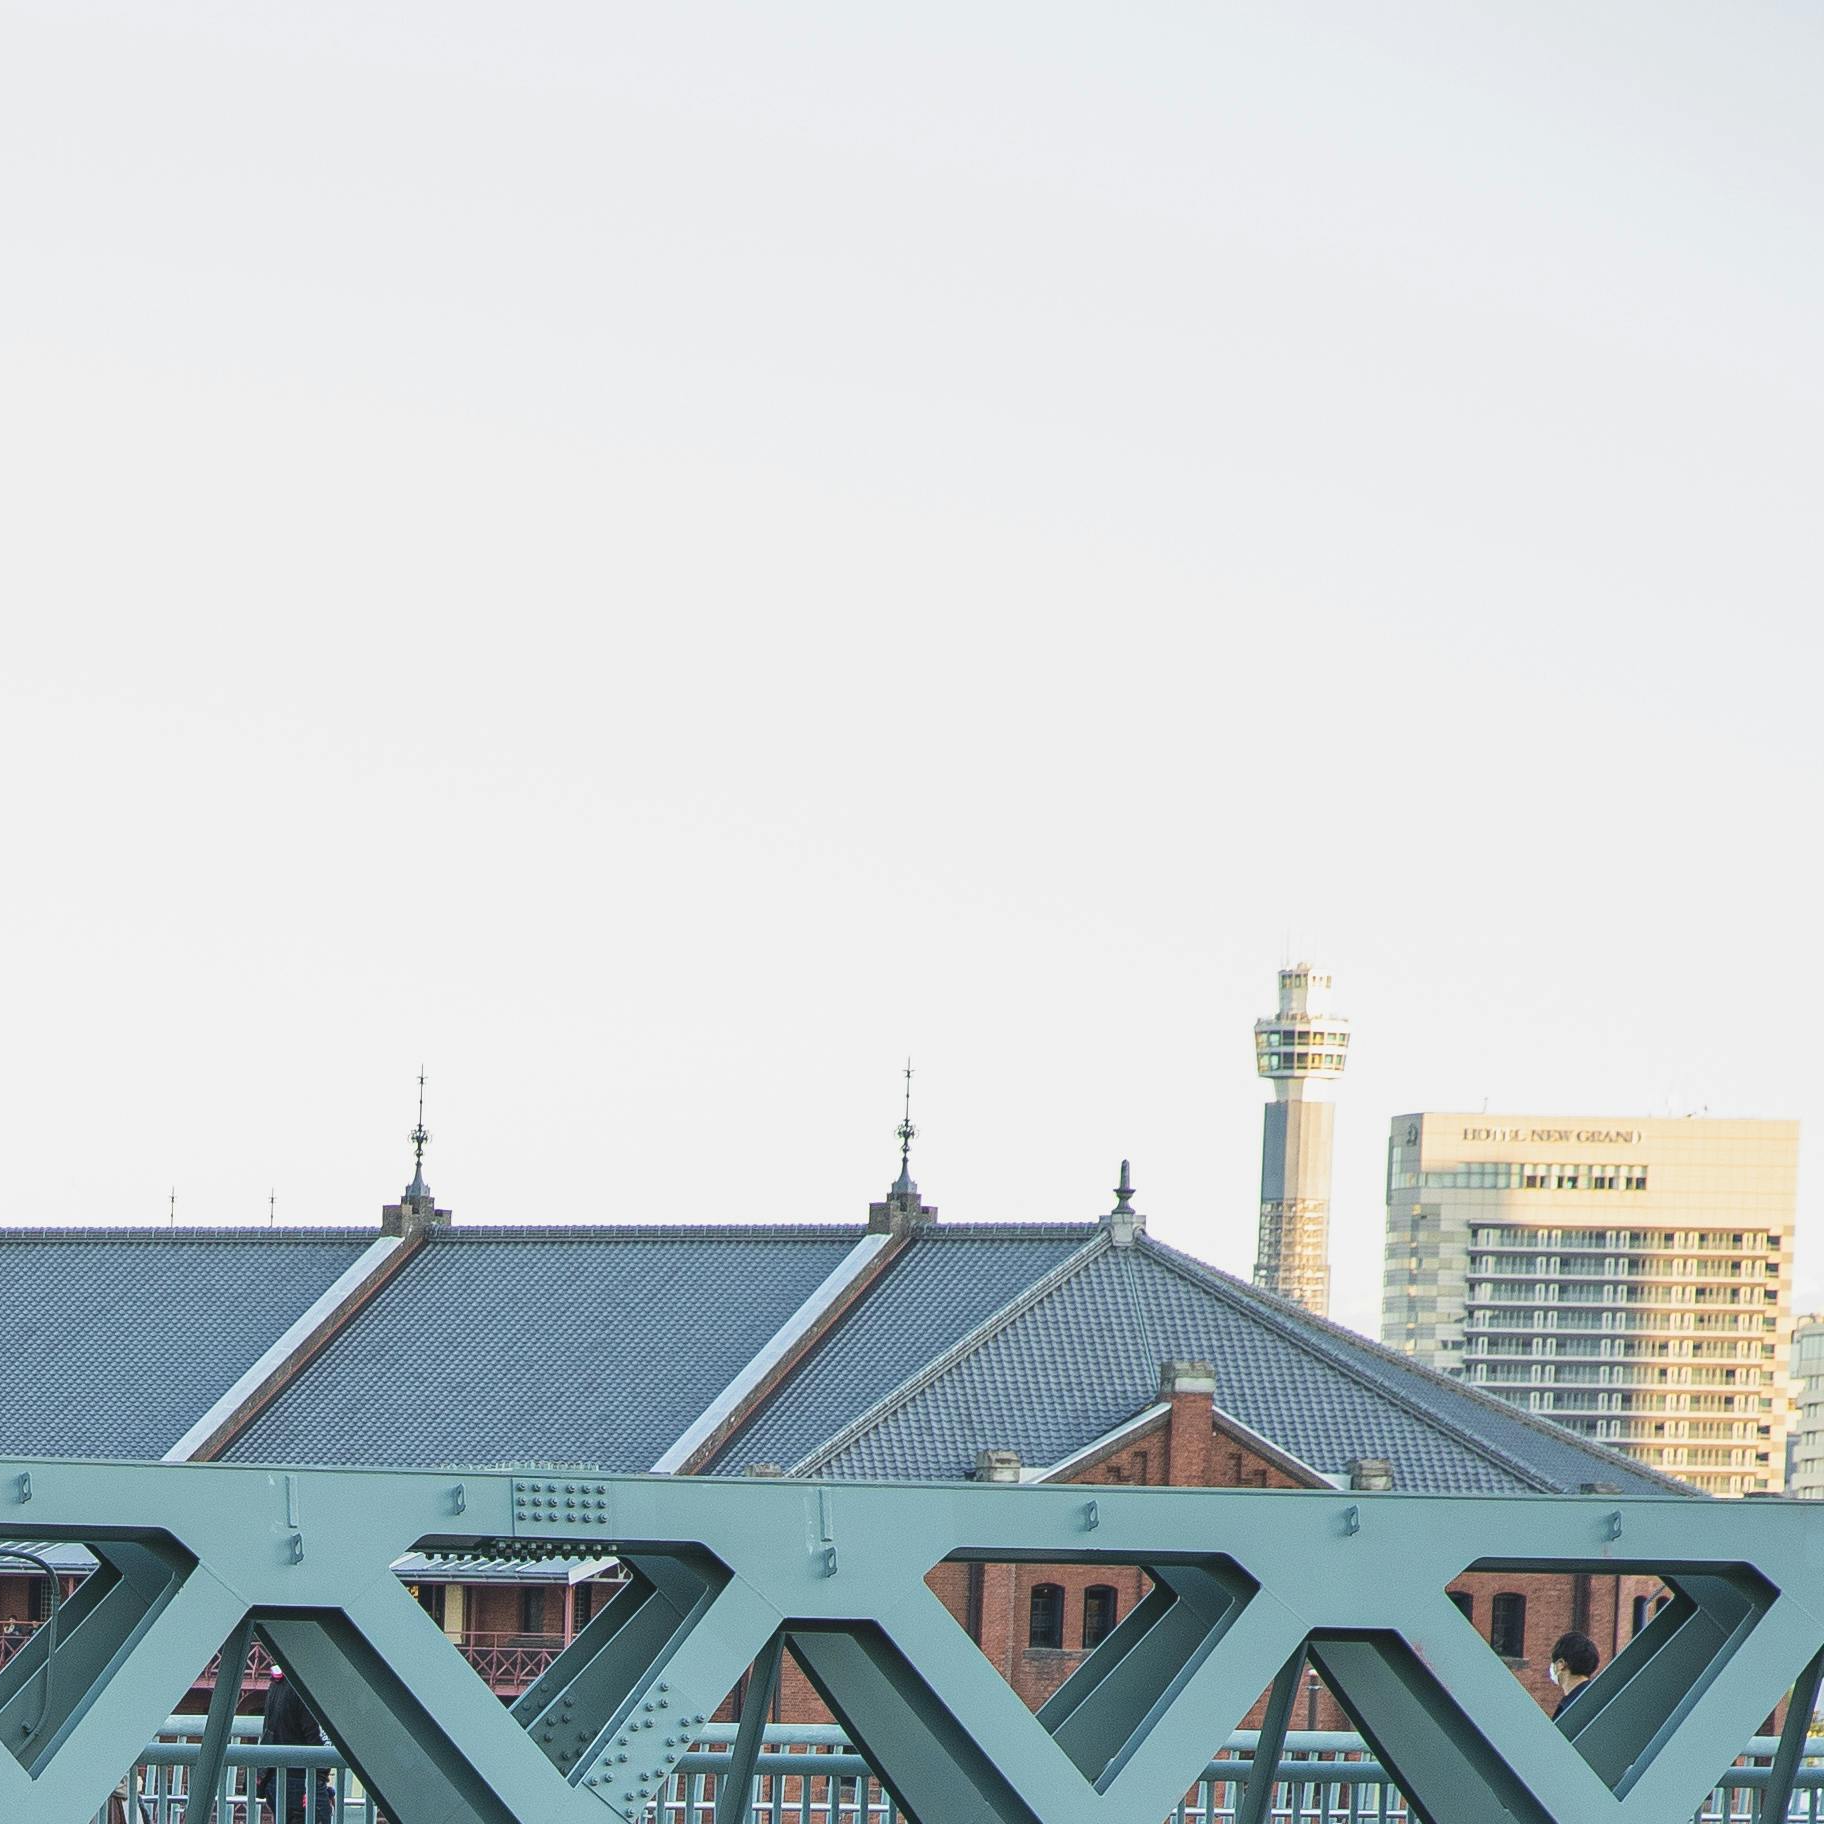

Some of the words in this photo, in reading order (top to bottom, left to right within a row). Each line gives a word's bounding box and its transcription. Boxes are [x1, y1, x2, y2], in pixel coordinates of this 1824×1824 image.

[1463, 1127, 1526, 1142] HOTEL
[1530, 1128, 1573, 1143] NEW
[1576, 1129, 1642, 1144] GRAND
